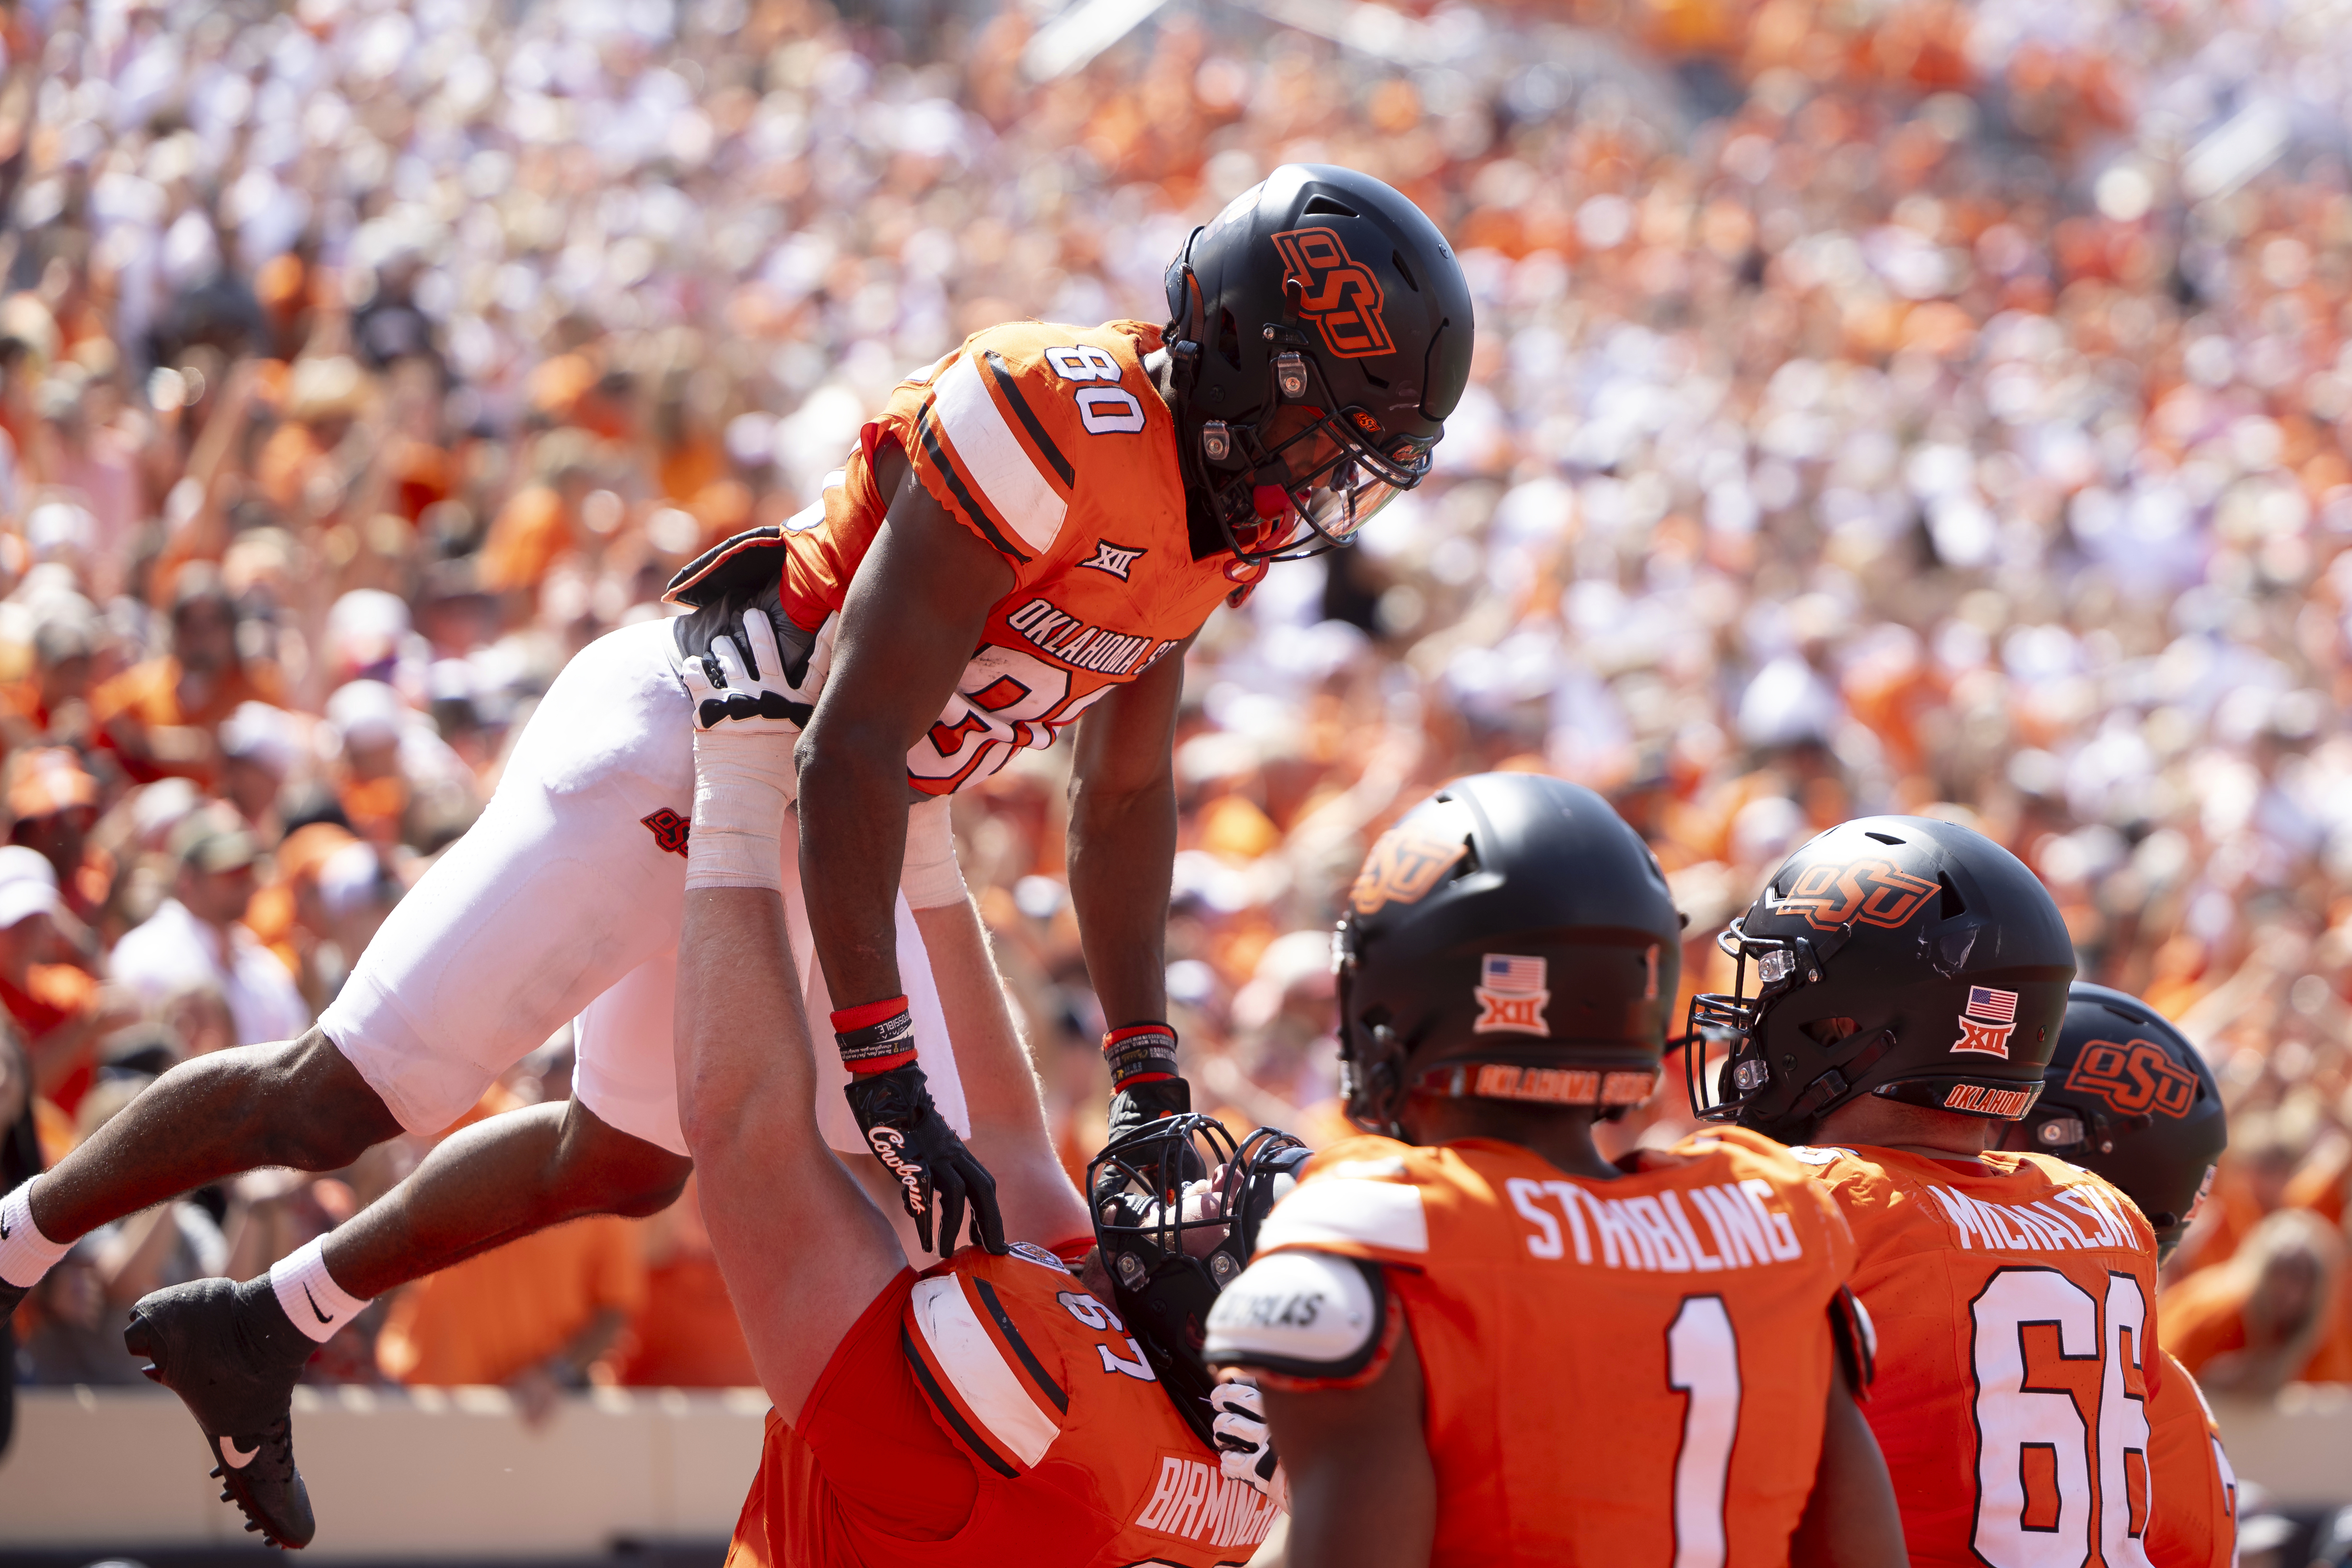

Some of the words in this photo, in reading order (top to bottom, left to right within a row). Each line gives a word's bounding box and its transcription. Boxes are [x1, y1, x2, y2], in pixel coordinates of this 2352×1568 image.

[1271, 227, 1396, 358] OSU
[1044, 344, 1147, 435] 80
[1353, 412, 1381, 432] OSU
[1007, 598, 1153, 675] OKLAHOMA
[640, 807, 691, 858] OS
[1776, 858, 1941, 931] OSU
[875, 1012, 909, 1034] POSSIBLE.
[1952, 1017, 2015, 1059] XII
[1475, 1064, 1601, 1104] OKLAHOMA
[2064, 1038, 2200, 1118] OSU
[868, 1125, 926, 1216] Cowboys
[1505, 1178, 1803, 1272] STRIBLING
[1927, 1184, 2140, 1251] MICHALSKI
[1056, 1291, 1157, 1382] 67
[1666, 1292, 1743, 1568] 1
[1968, 1265, 2152, 1568] 66
